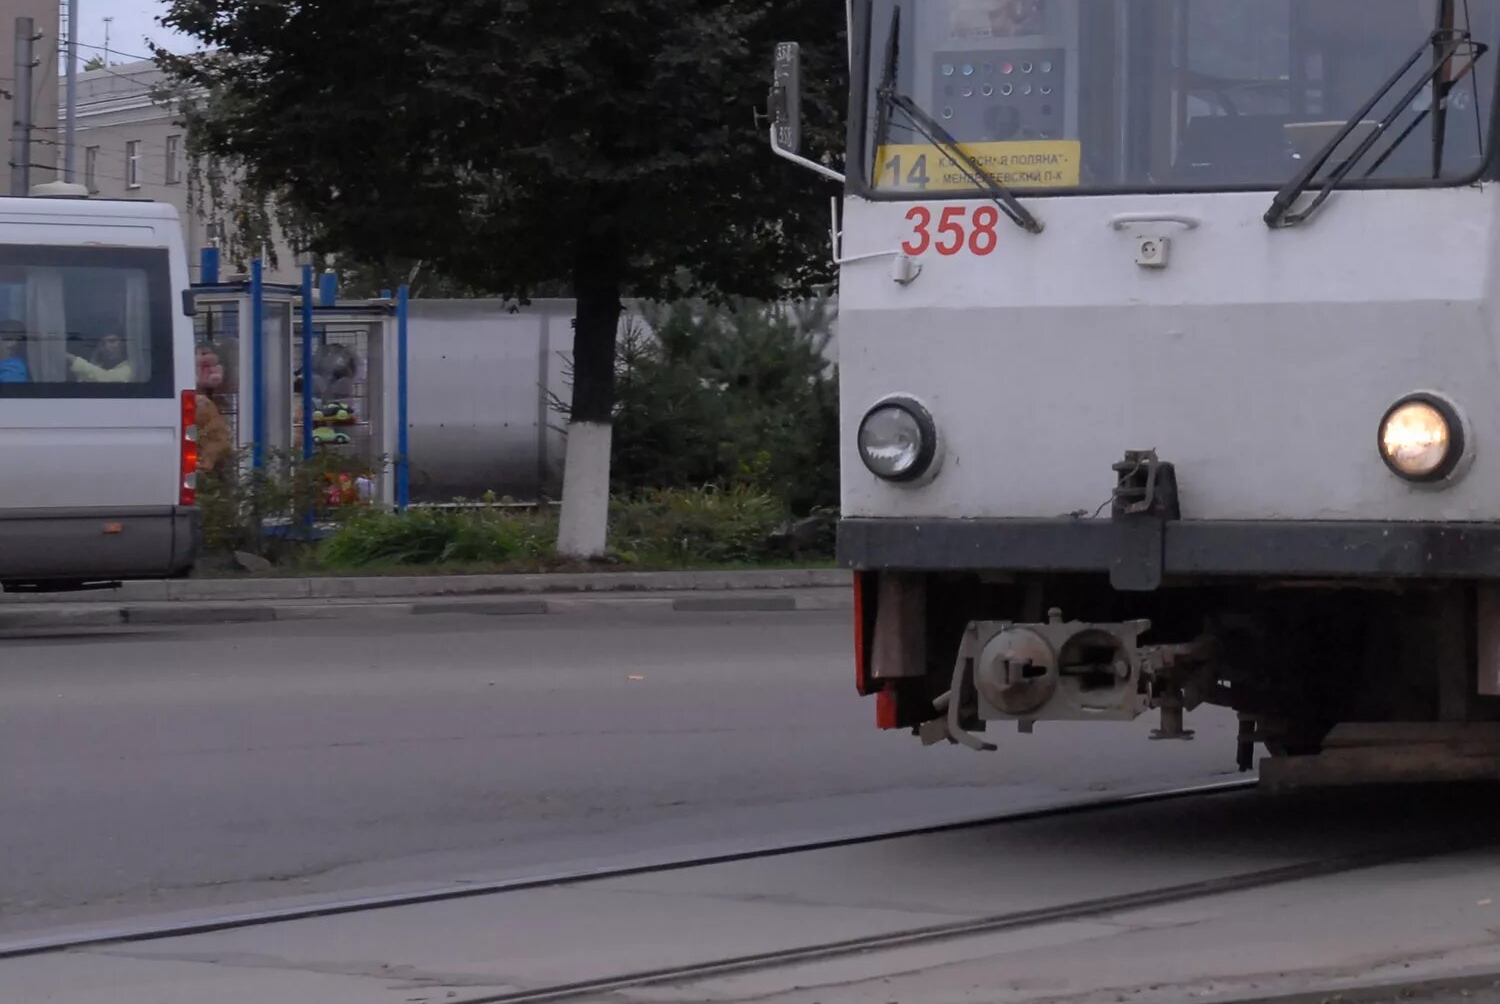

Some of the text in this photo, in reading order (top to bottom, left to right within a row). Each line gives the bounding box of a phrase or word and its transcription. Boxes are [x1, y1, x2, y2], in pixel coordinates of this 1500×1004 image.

[885, 153, 930, 189] 14
[943, 169, 1042, 184] МЕНДЕЕВСКИЙ
[901, 205, 999, 256] 358
